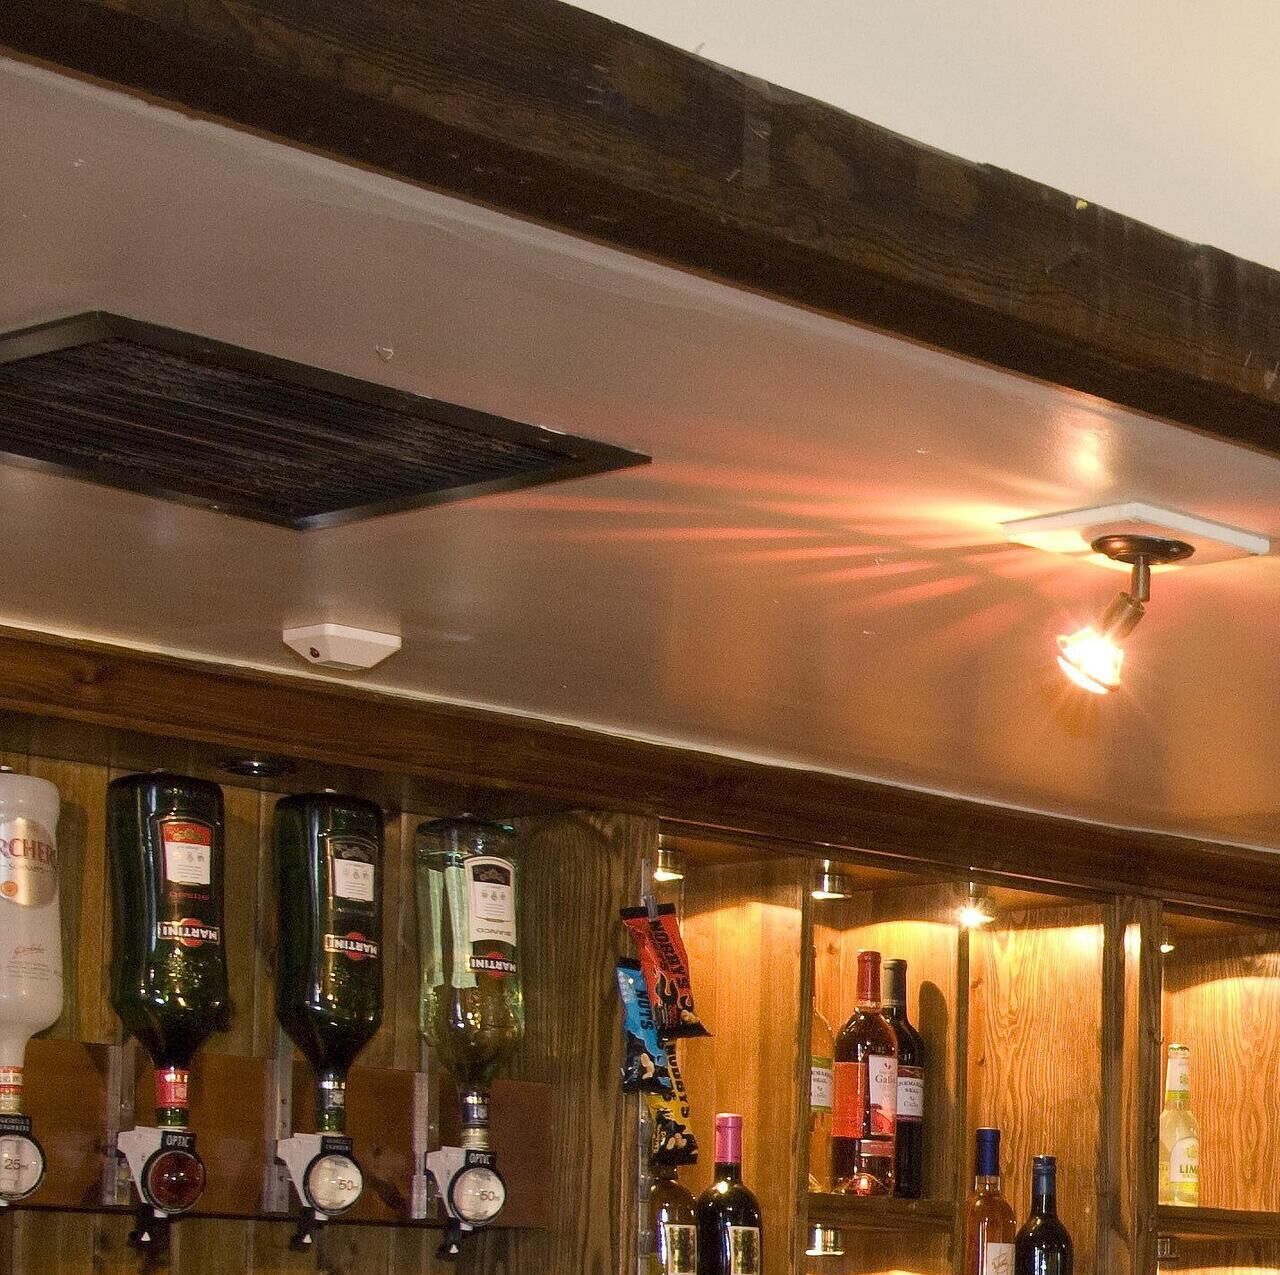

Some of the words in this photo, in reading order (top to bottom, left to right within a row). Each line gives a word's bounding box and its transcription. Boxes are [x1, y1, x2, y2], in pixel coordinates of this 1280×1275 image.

[162, 925, 218, 940] MARTINI
[327, 938, 378, 956] MARTINI
[470, 957, 517, 974] MARTINI
